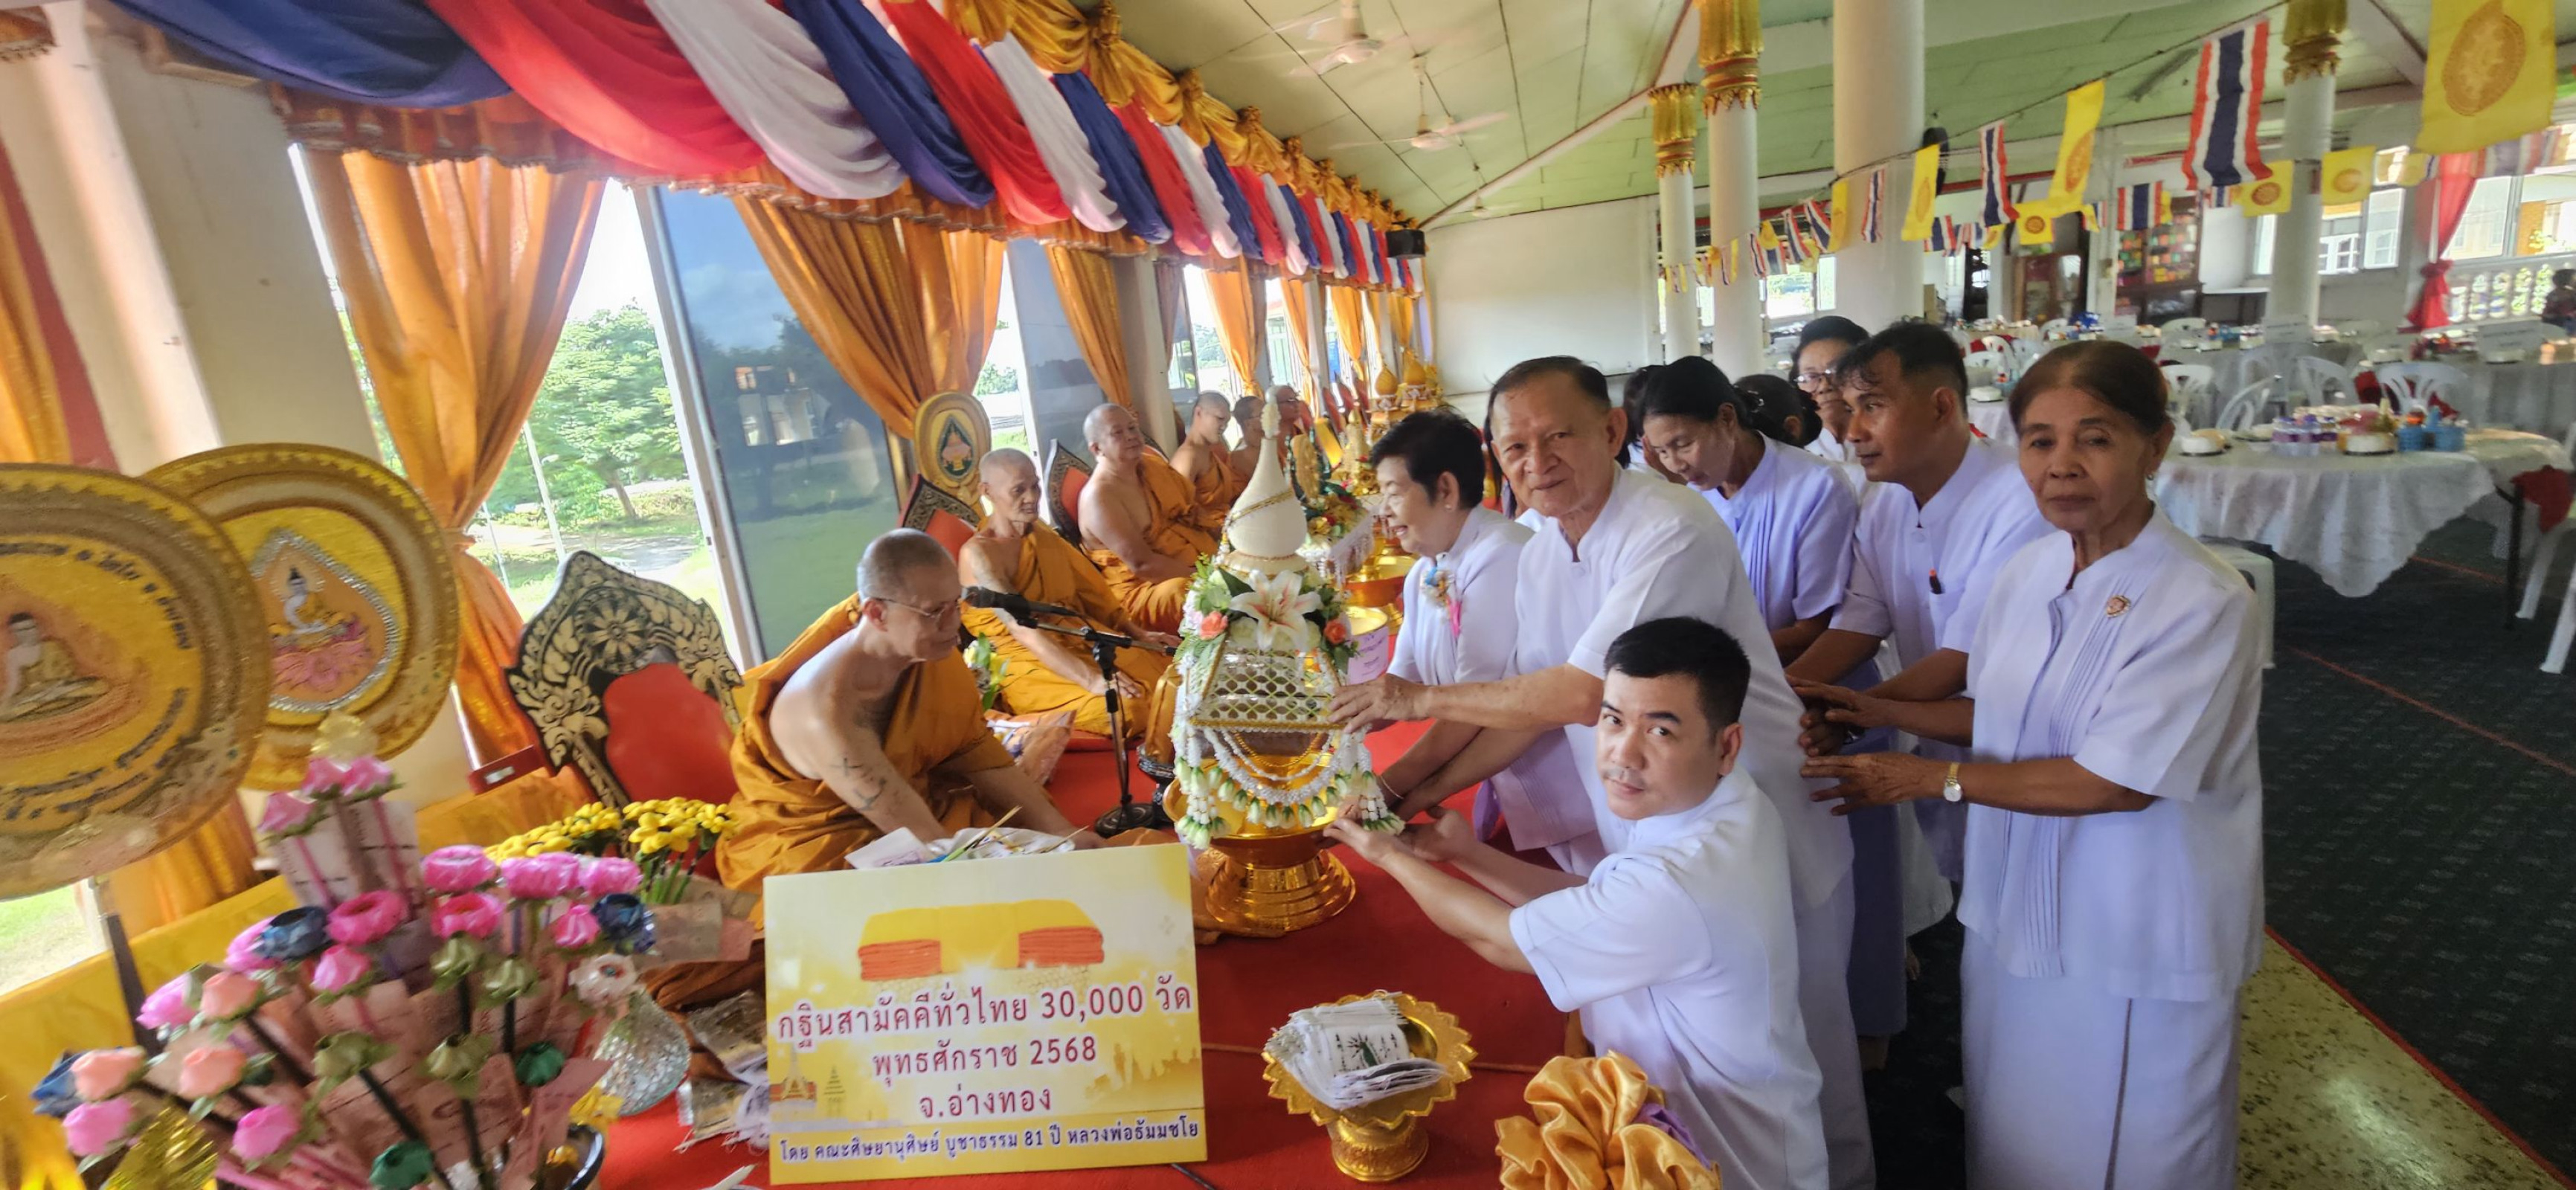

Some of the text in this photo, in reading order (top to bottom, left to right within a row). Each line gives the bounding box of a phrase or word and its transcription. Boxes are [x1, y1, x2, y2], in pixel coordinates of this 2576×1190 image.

[779, 974, 1192, 1049] กฐินสามัคคีทั่วไทย 30,000 วัด
[873, 1035, 1097, 1087] พุทธศักราช 2568
[919, 1083, 1052, 1118] จ.อ่างทอง
[780, 1115, 1199, 1162] โดย คณะศิษยานุศิษย์ บูชาธรรม 81 ปี หลวงพ่อธัมมชโย
